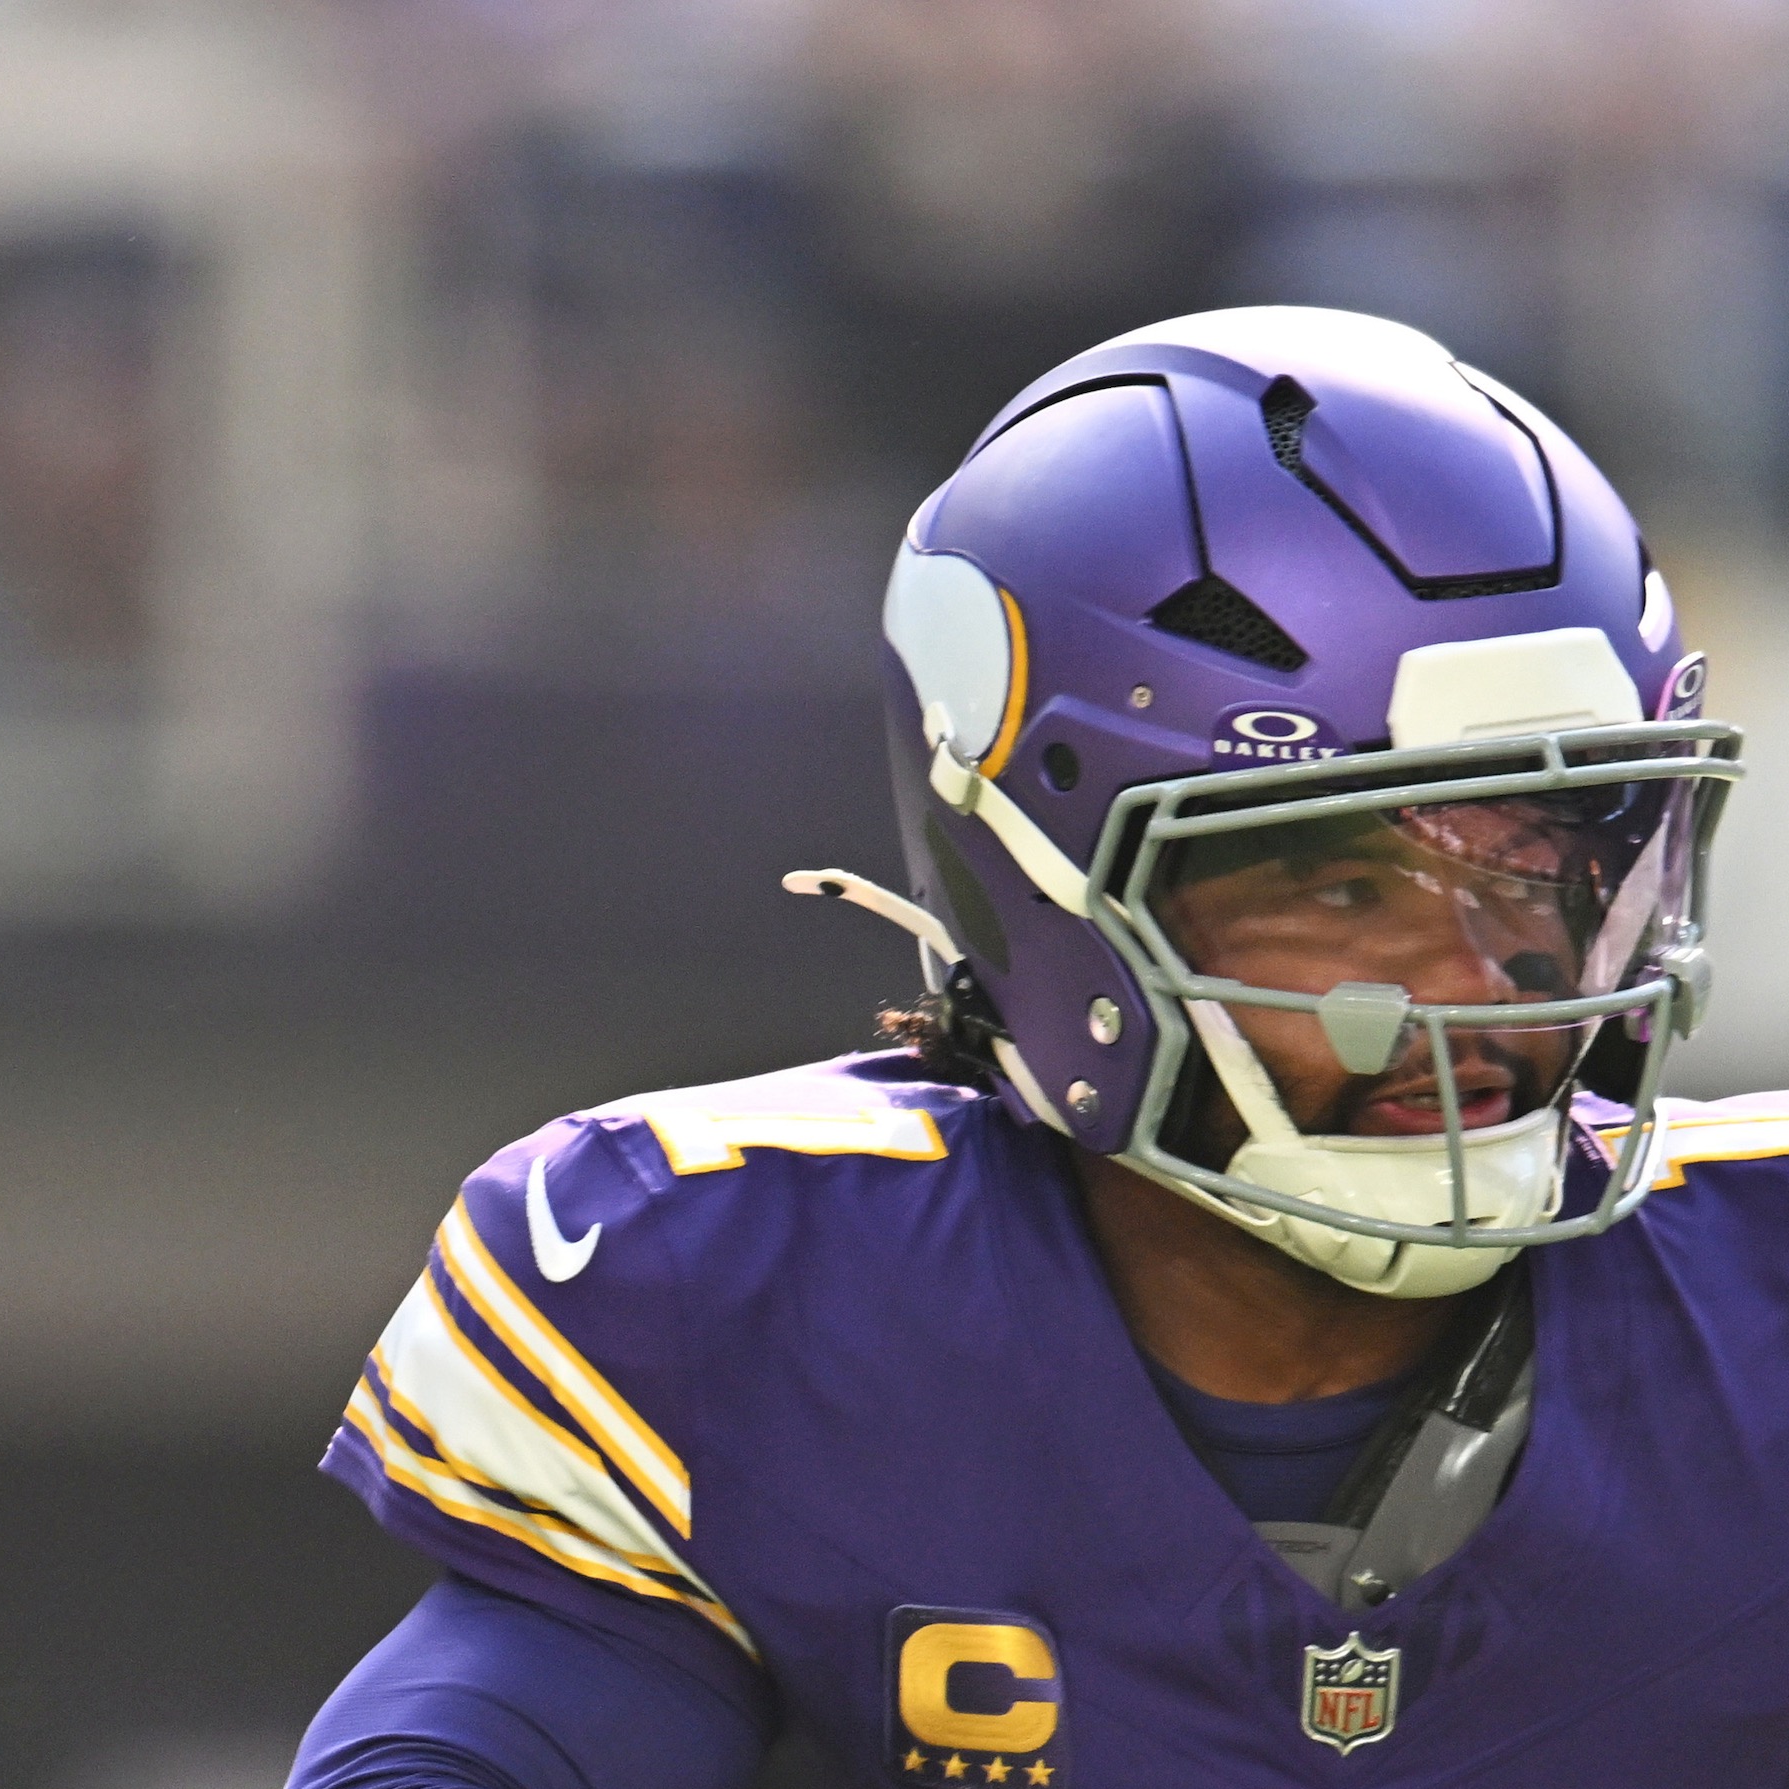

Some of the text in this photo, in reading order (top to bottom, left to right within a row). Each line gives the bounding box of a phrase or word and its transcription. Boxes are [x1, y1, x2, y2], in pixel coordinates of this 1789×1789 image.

[1214, 739, 1343, 760] OAKLEY
[898, 1622, 1059, 1754] C
[1317, 1691, 1380, 1733] NFL
